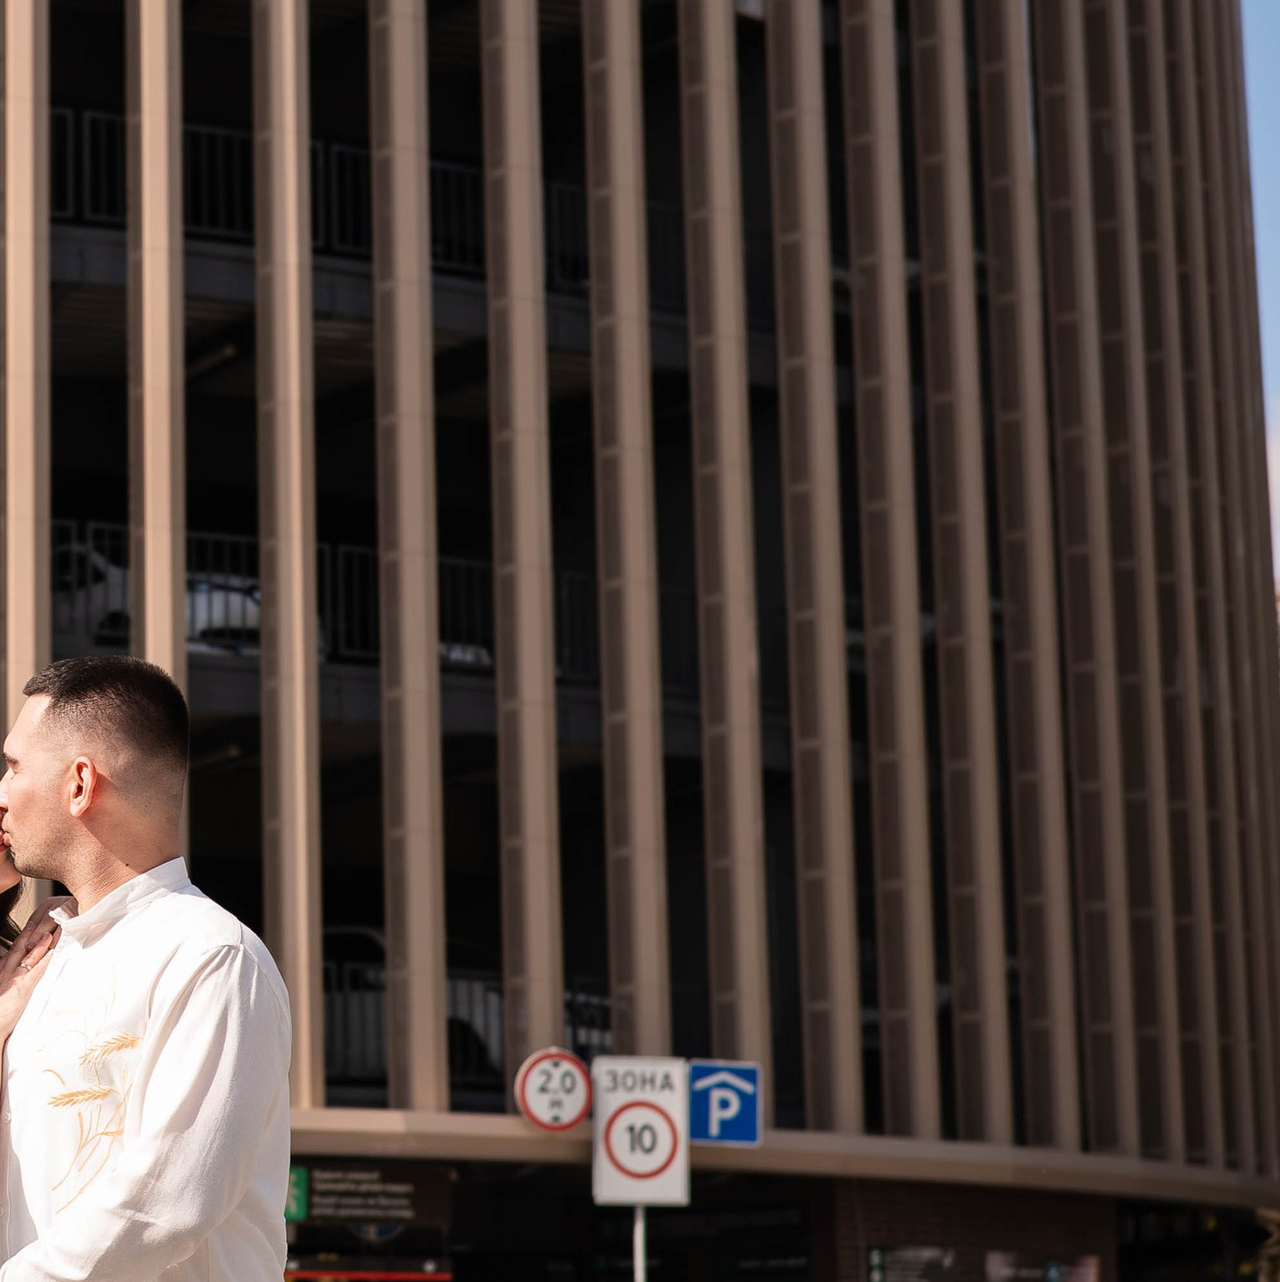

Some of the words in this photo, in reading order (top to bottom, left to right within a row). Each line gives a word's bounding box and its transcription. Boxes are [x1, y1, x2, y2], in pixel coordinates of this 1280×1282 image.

[605, 1070, 675, 1092] ЗОНА
[709, 1088, 741, 1137] P
[626, 1123, 658, 1154] 10
